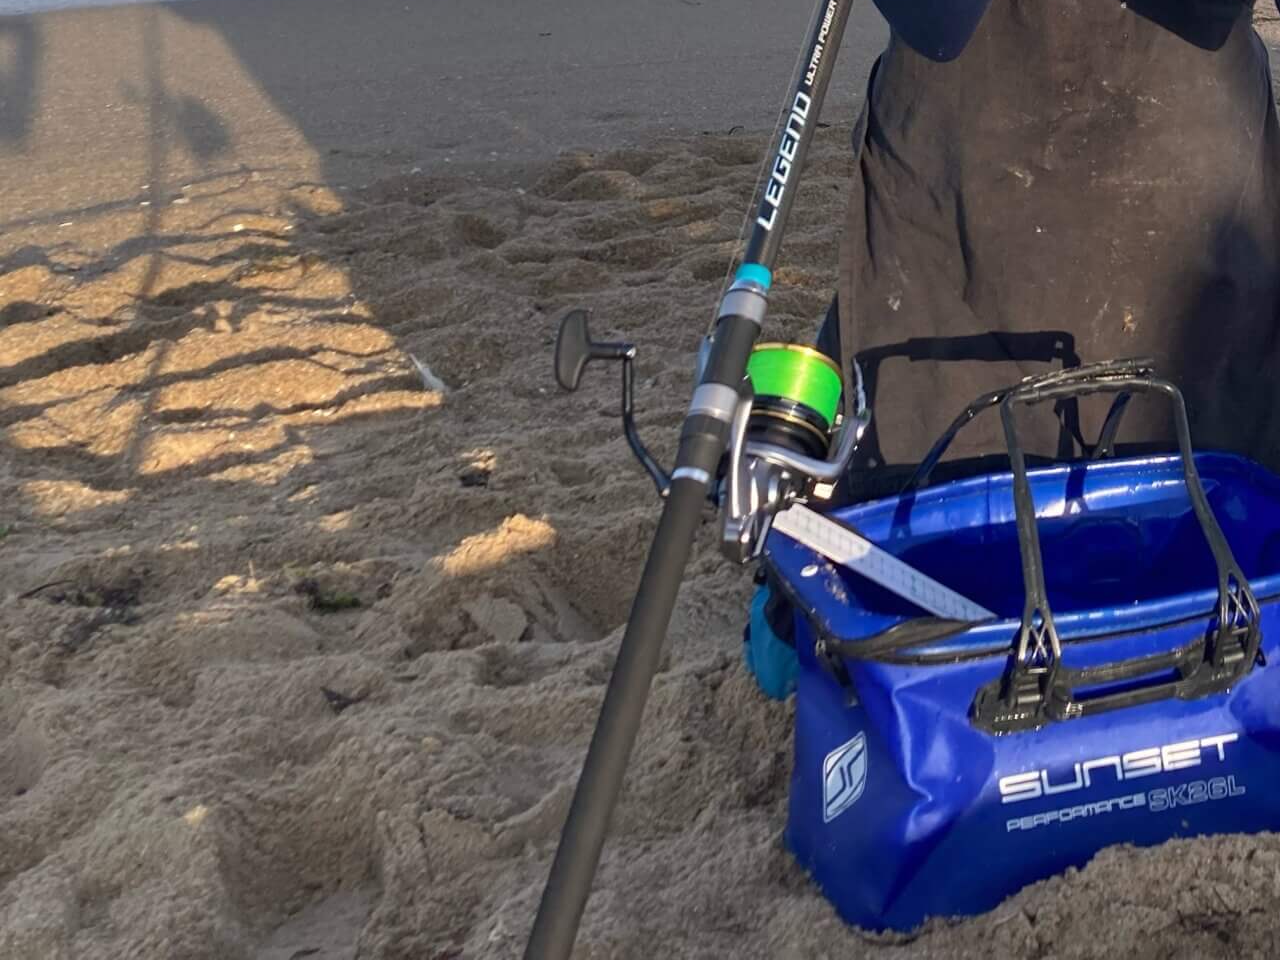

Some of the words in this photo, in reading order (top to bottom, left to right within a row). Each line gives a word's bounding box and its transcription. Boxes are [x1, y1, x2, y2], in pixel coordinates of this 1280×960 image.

[757, 91, 811, 232] LEGEND
[804, 44, 823, 86] ULTRA
[818, 0, 838, 43] POWER
[998, 732, 1239, 804] SUNSET
[1006, 791, 1147, 833] PERFORMANCE
[1148, 774, 1247, 812] SK26L
